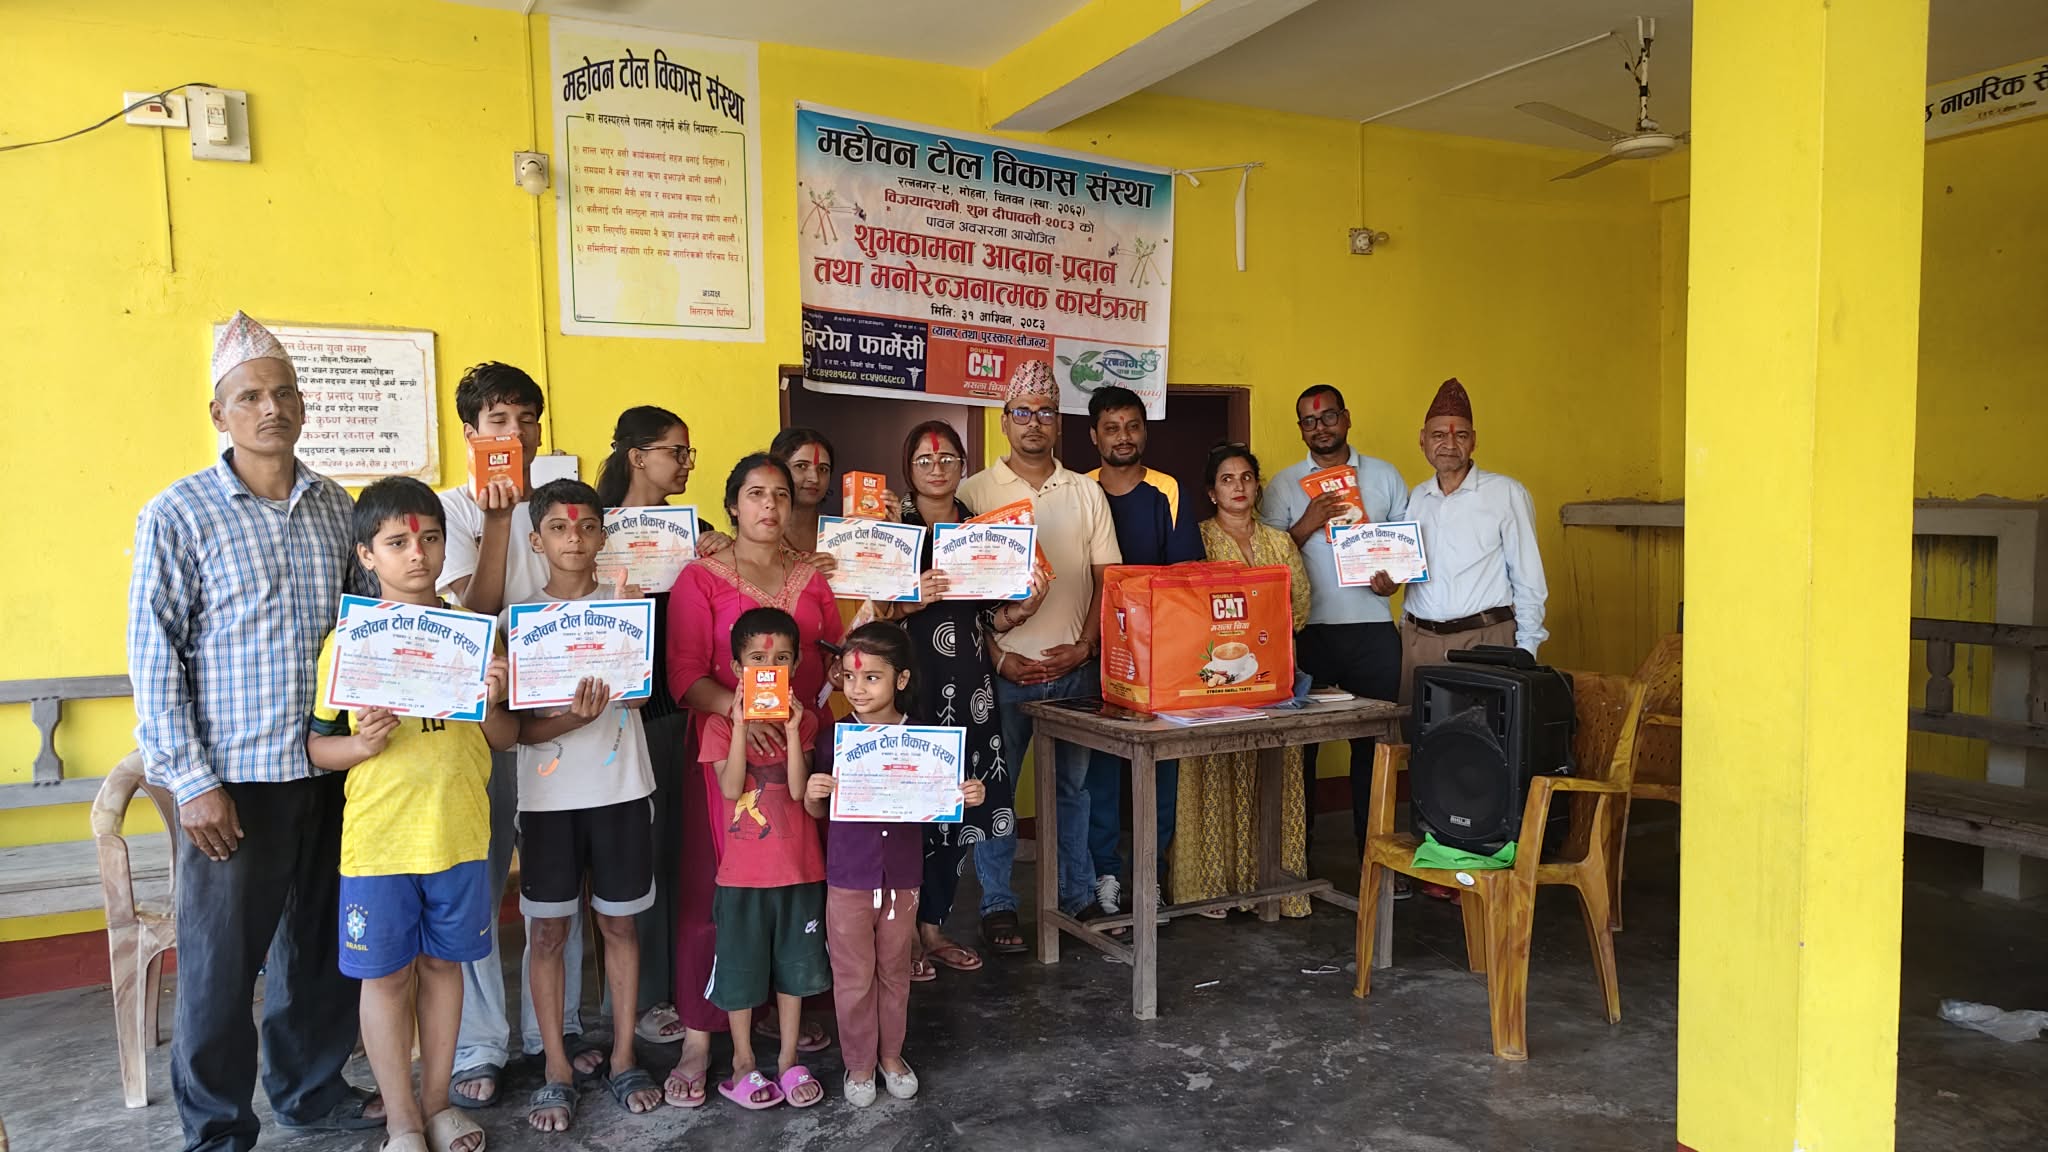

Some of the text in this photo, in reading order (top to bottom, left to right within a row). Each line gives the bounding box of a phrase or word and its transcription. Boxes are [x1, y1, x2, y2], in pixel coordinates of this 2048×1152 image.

[563, 48, 745, 125] महोवन टोल विकास संस्था
[1940, 75, 2027, 115] नागरिक
[634, 117, 652, 129] पालना
[816, 125, 1154, 208] महोवन टोल विकास संस्था
[994, 189, 1025, 206] चितवन
[926, 216, 1056, 245] पावन अवसरमा आयोजित
[966, 204, 988, 218] शुभ
[1079, 221, 1094, 234] को
[854, 224, 975, 265] शुभकामना
[814, 255, 1148, 323] तथा मनोरन्जनात्मक कार्यक्रम
[961, 310, 974, 321] ३१
[1020, 318, 1045, 331] २०८३
[803, 320, 926, 360] निरोग फार्मेसी
[961, 329, 978, 340] तथा
[968, 353, 1004, 378] CAT
[490, 453, 509, 466] CAT
[1320, 478, 1344, 492] CAT
[622, 516, 638, 529] टोल
[640, 514, 666, 530] विकास
[668, 520, 690, 540] संस्था
[855, 527, 869, 539] टोल
[871, 527, 894, 543] विकास
[969, 531, 983, 543] टोल
[985, 530, 1008, 545] विकास
[1212, 598, 1244, 619] CAT
[350, 613, 480, 657] महोवन टोल विकास संस्था
[521, 609, 643, 646] महोवन टोल विकास संस्था
[757, 671, 776, 682] CAT
[845, 733, 956, 766] महोवन टोल विकास संस्था
